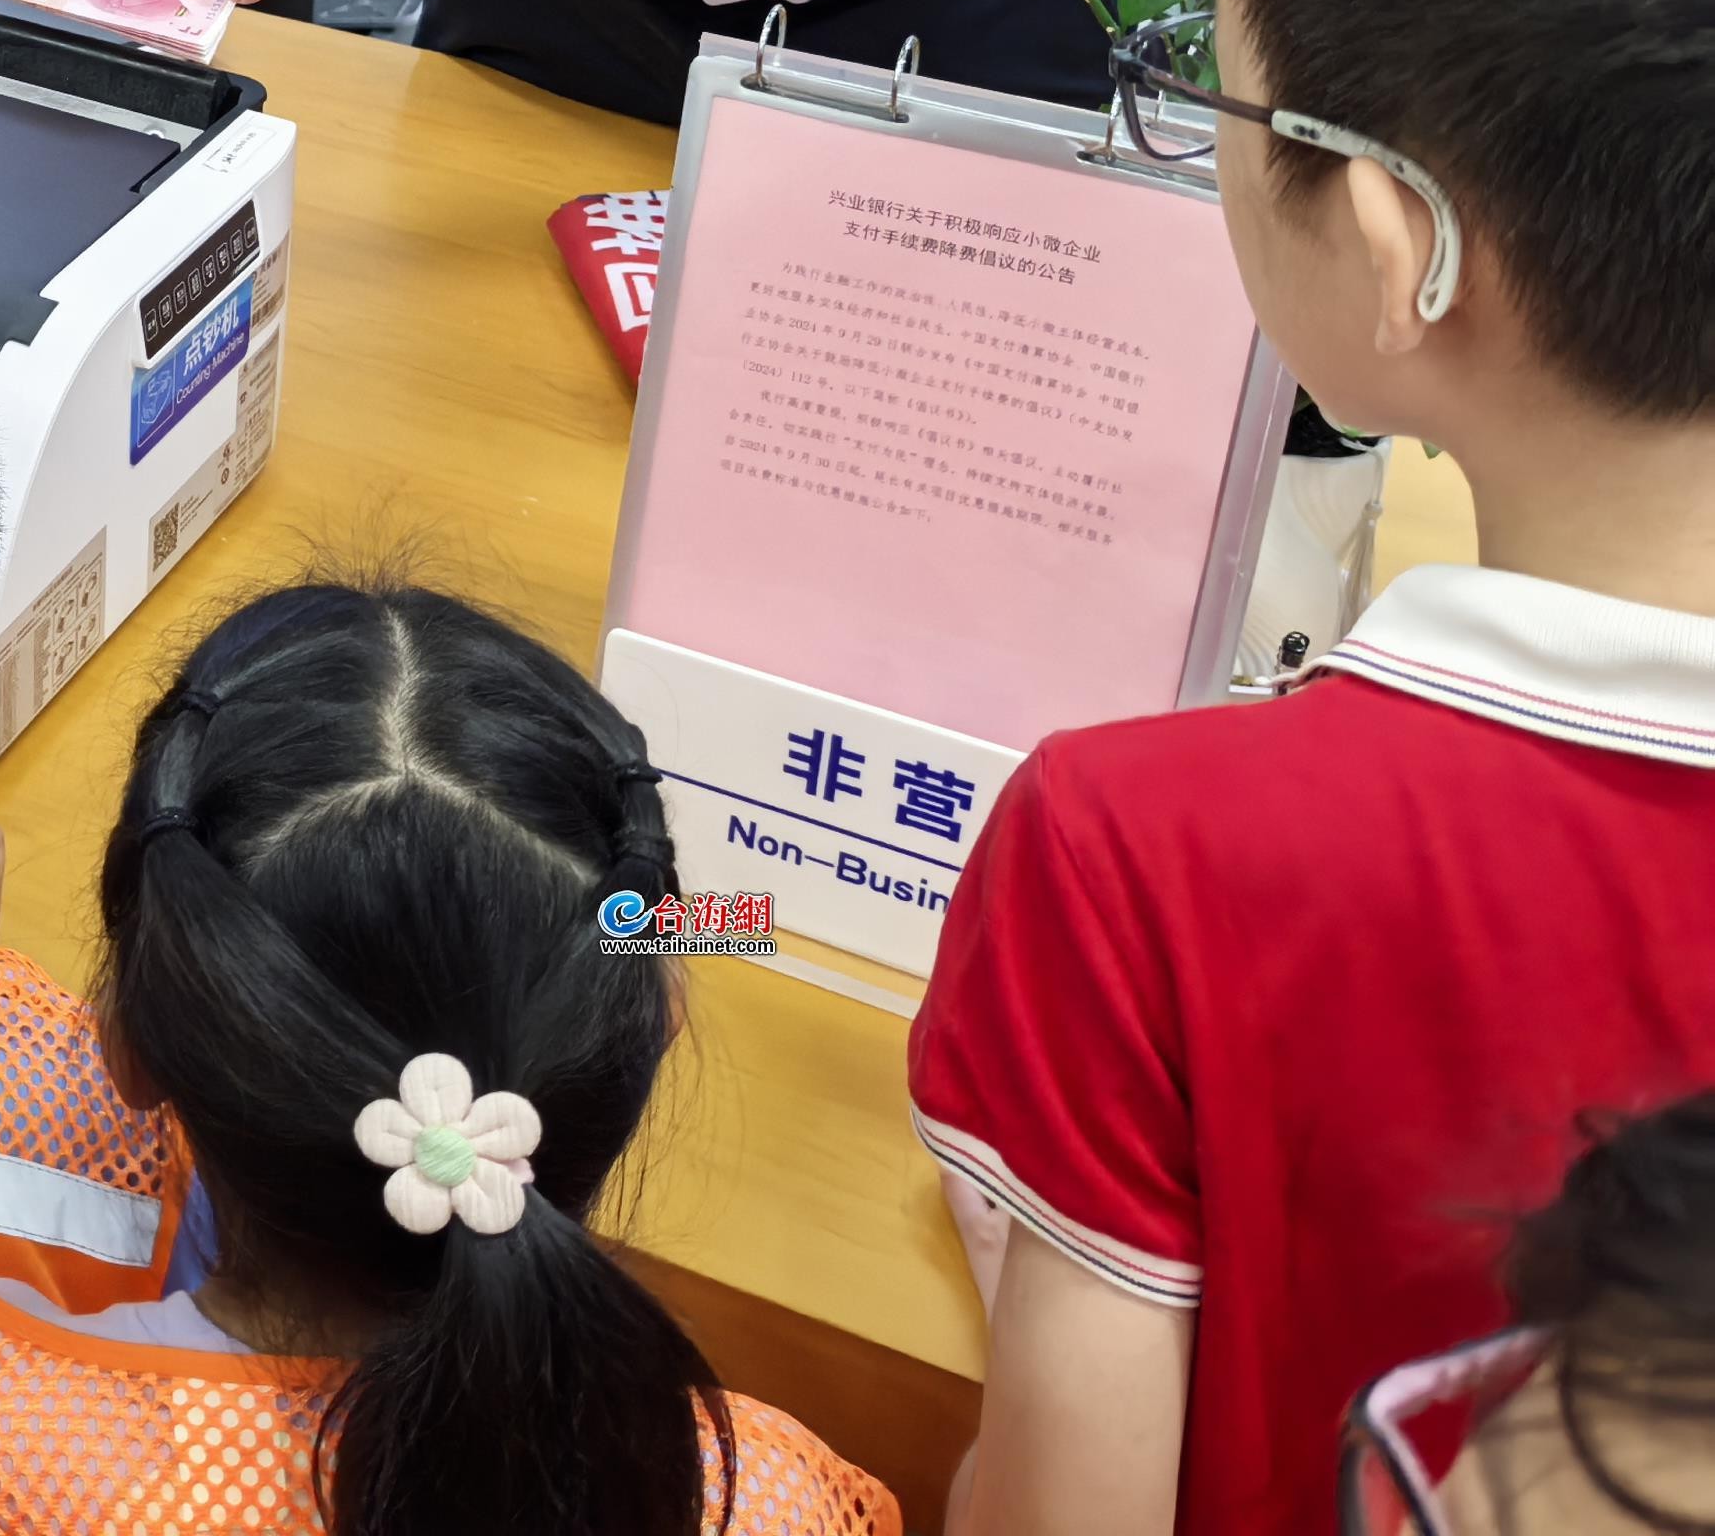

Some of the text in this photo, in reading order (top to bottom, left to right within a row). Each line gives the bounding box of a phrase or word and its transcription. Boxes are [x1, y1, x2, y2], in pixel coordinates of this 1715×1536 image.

[827, 188, 1103, 263] 兴业银行关于积极响应小微企业
[842, 219, 1077, 286] 支付手续费降费倡议的公告
[177, 331, 245, 404] Counting Machine
[183, 295, 239, 377] 点钞机
[783, 728, 975, 843] 非营
